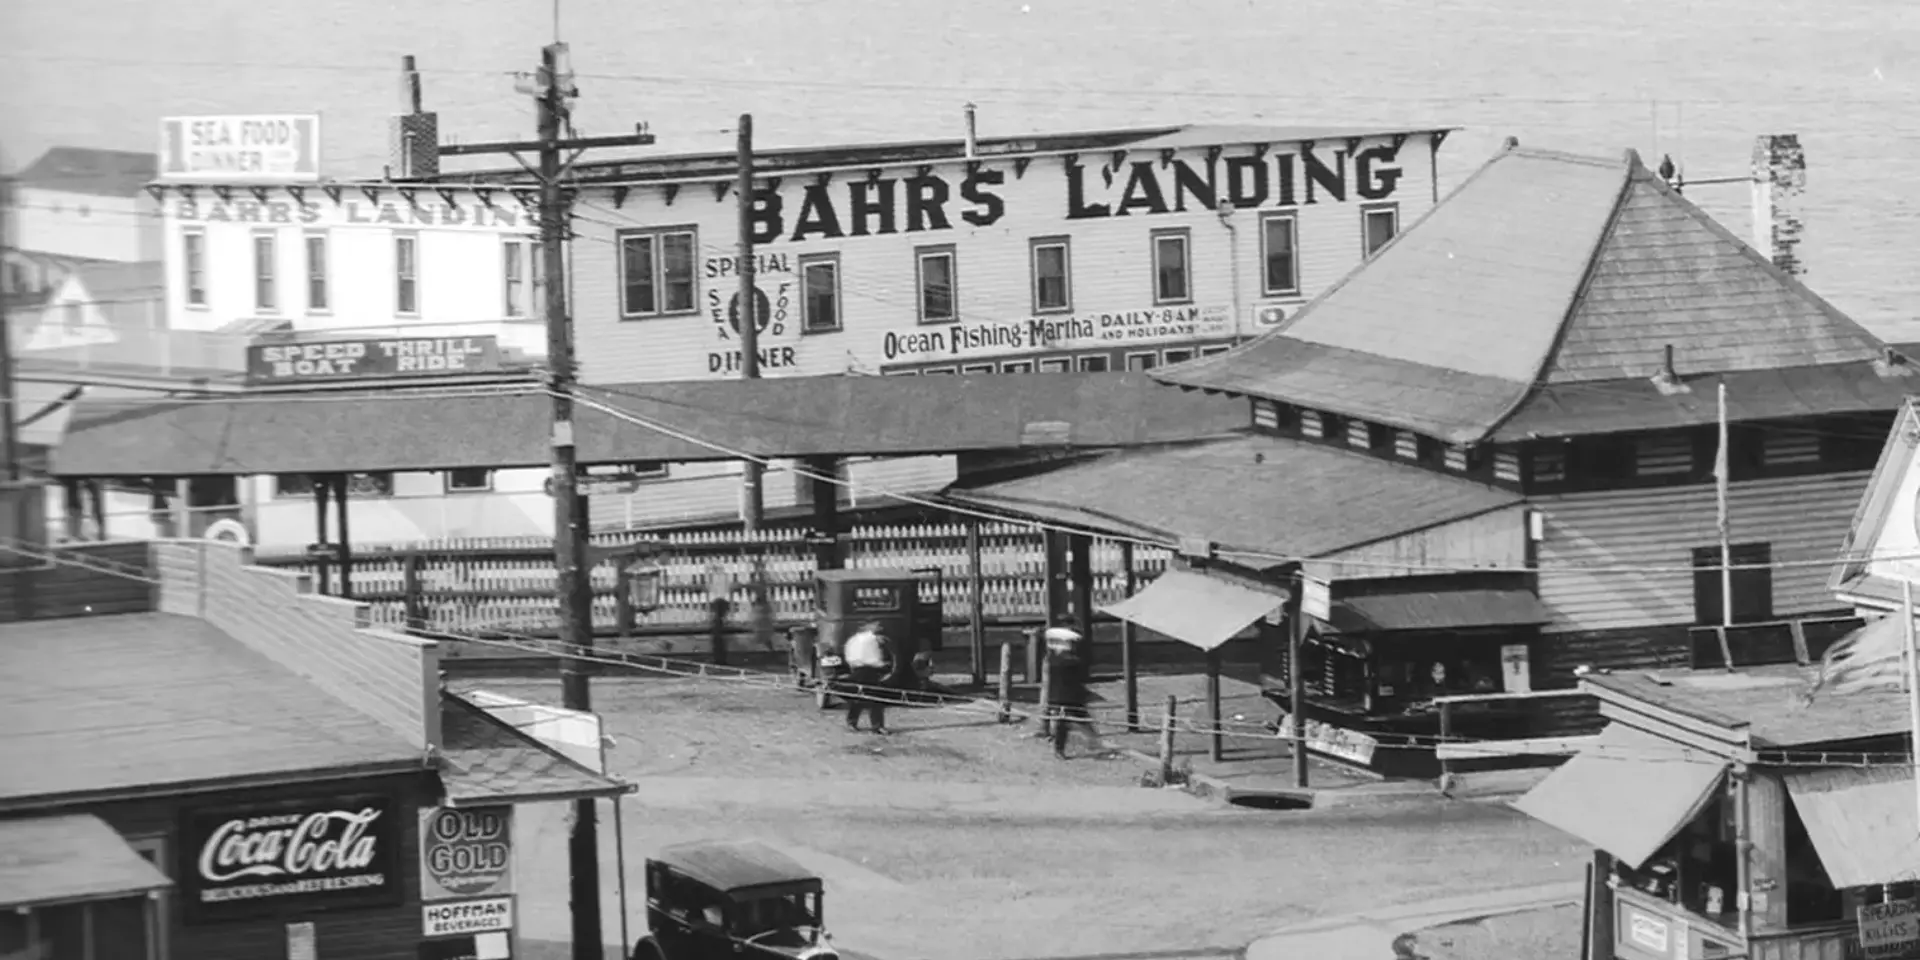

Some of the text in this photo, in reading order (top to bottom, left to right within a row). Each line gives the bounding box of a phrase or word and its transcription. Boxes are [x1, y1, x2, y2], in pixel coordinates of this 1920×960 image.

[190, 119, 290, 146] SEA FOOD
[738, 144, 1403, 244] BAHRS LANDING
[176, 201, 322, 223] BAHRS
[261, 338, 483, 362] SPEED THRILL
[884, 331, 945, 360] Ocean
[272, 353, 466, 377] BOAT RIDE
[431, 810, 502, 842] OLD
[199, 807, 383, 881] Coca-Cola
[427, 841, 509, 875] GOLD
[428, 903, 507, 921] HOFFMAN
[434, 917, 501, 932] BEVERAGES
